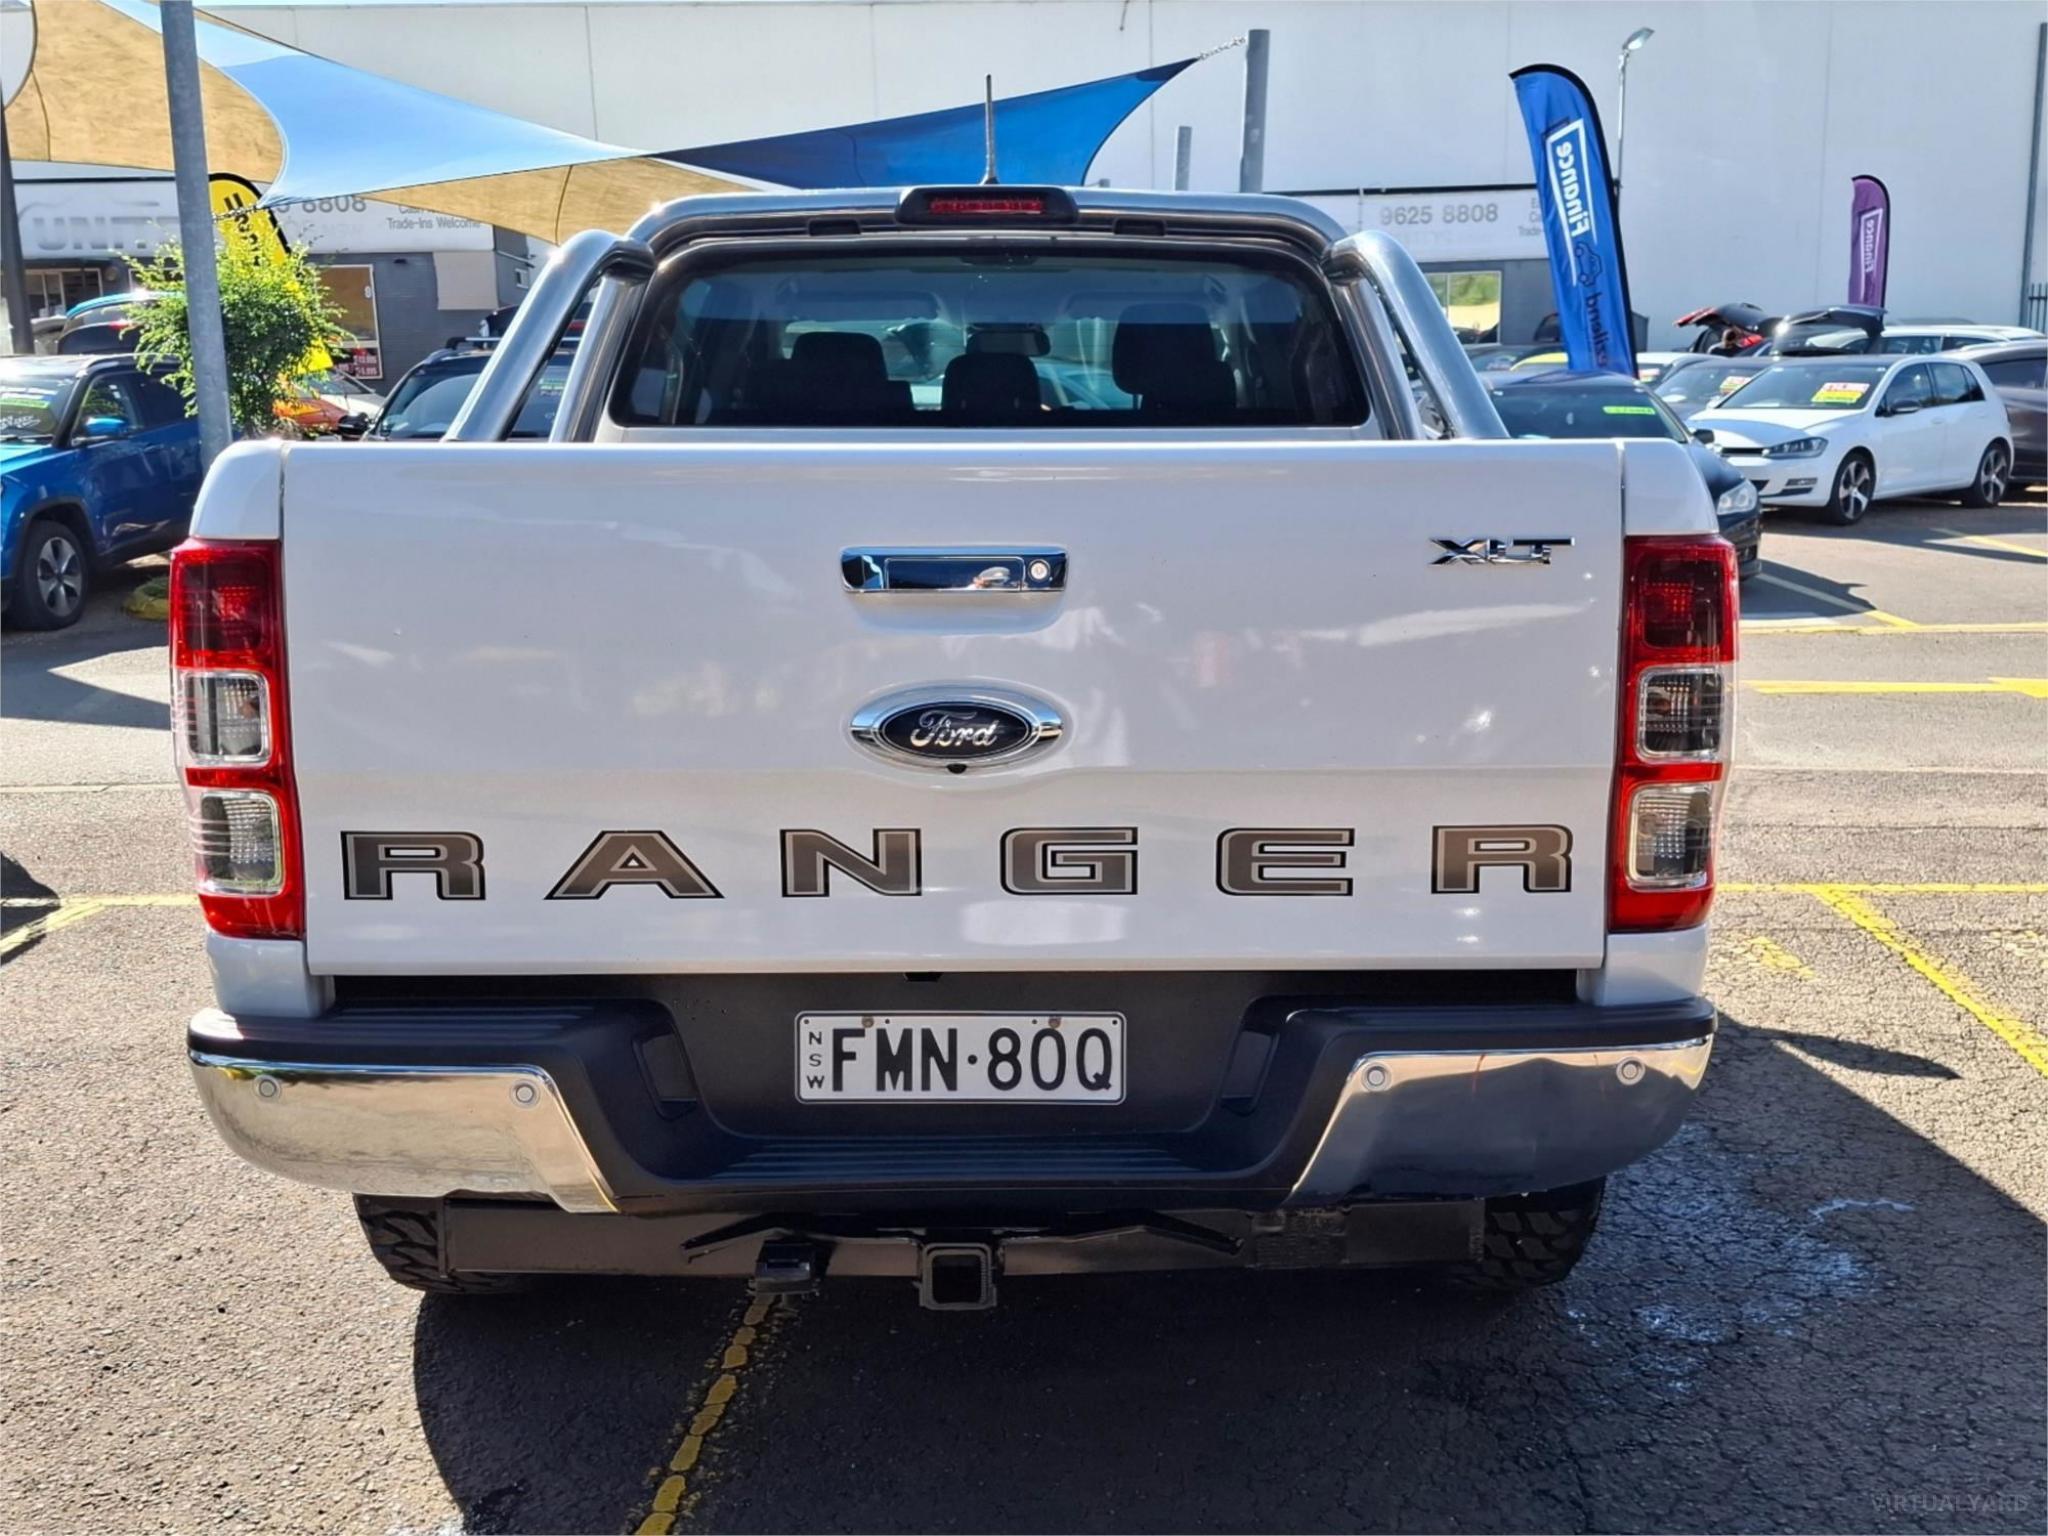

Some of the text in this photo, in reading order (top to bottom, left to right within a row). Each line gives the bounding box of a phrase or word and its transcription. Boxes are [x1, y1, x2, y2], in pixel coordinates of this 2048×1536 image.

[1382, 204, 1498, 225] 9625 8808
[1430, 537, 1575, 565] XLT
[910, 710, 998, 747] Ford
[341, 825, 1572, 900] RANGER
[806, 1031, 825, 1089] NSW
